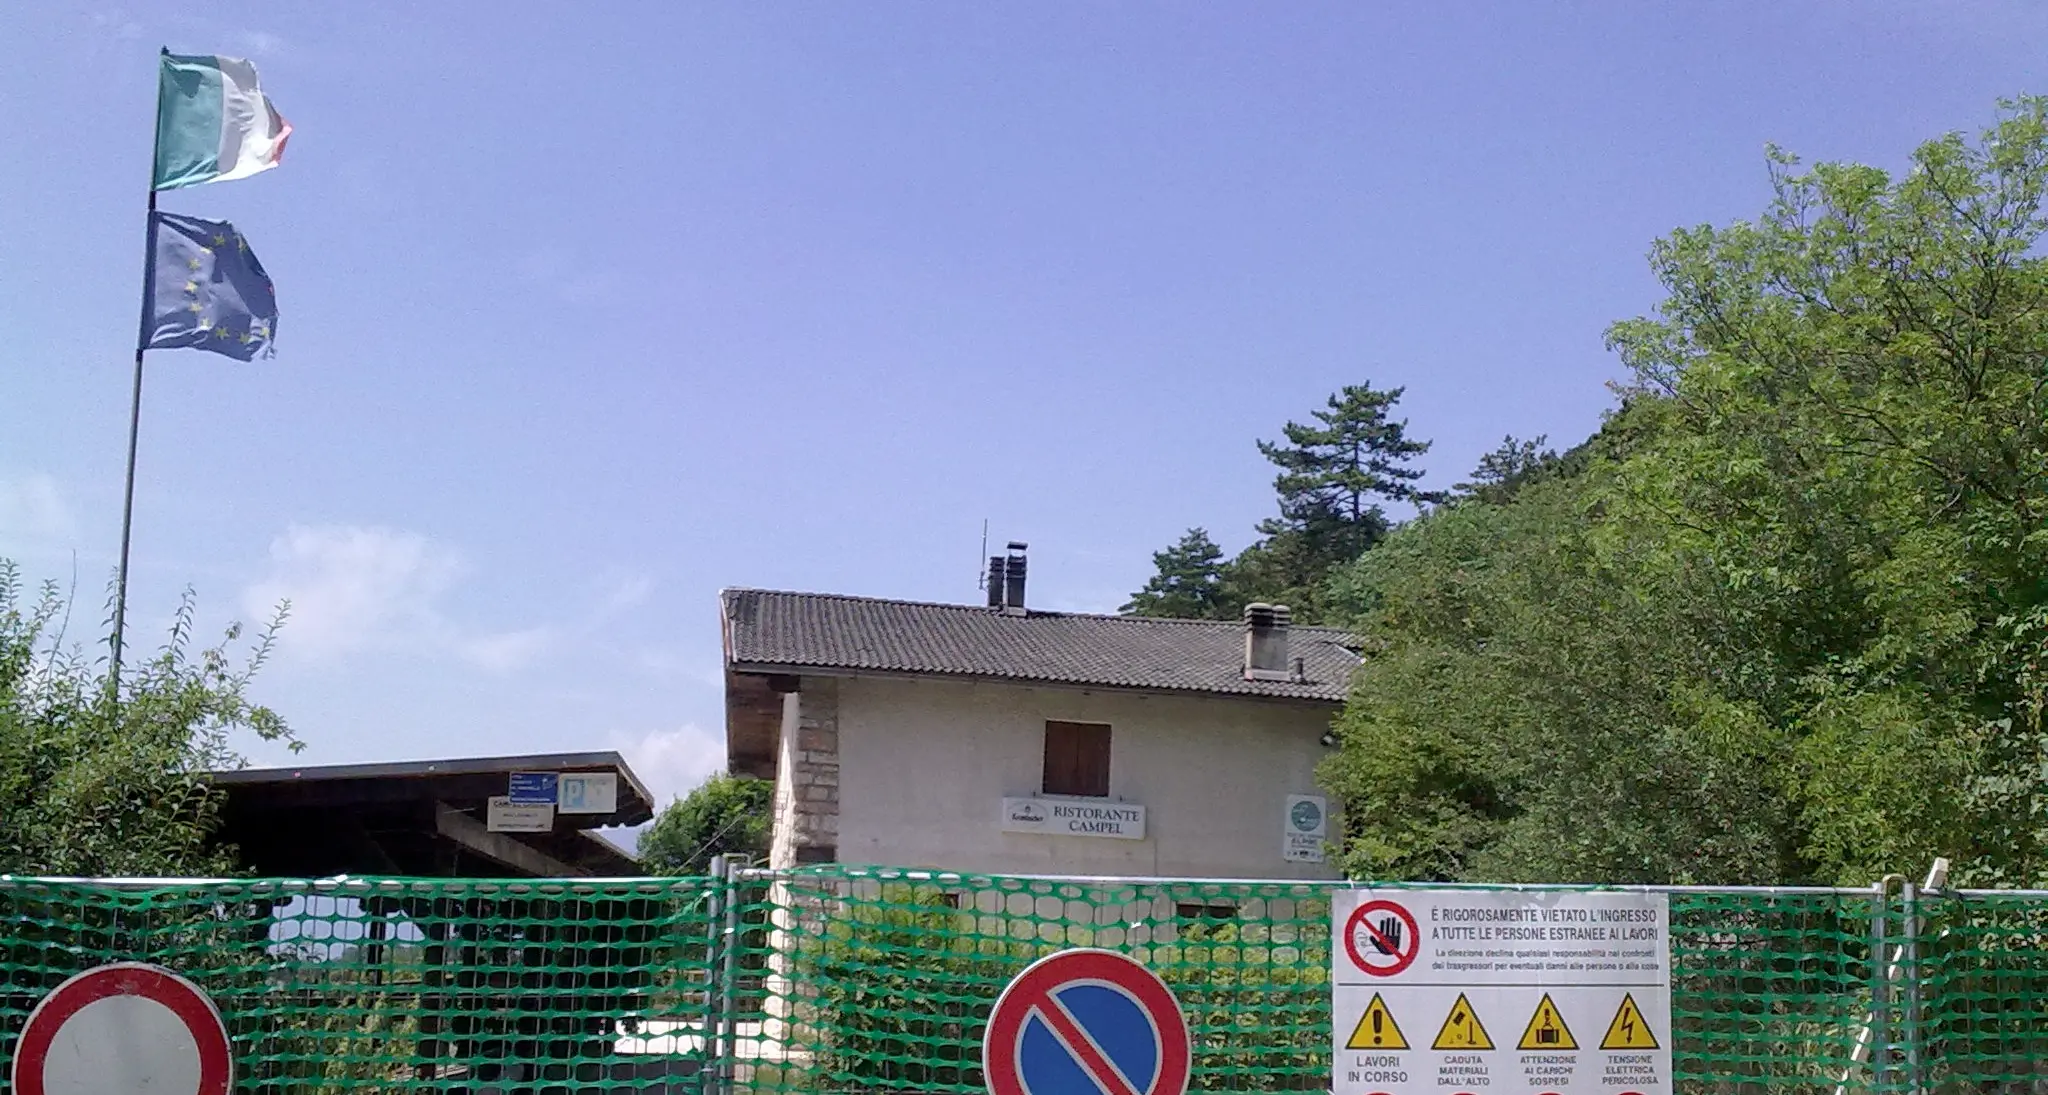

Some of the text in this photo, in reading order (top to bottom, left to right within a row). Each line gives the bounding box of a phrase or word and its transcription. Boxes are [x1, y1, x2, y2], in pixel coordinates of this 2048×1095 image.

[1053, 806, 1140, 822] RISTORANTE
[1069, 820, 1123, 834] CAMPEL
[1443, 908, 1537, 922] RIGOROSAMENTE
[1541, 909, 1587, 923] VIETATO
[1590, 909, 1657, 923] L'INGRESSO
[1432, 926, 1658, 941] A TUTTE LE PERSONE ESTRANEE AI LAVORI
[1436, 949, 1446, 957] La
[1448, 949, 1483, 957] direzione
[1486, 949, 1514, 957] declina
[1516, 949, 1550, 959] qualsiasi
[1622, 949, 1655, 958] confronti
[1432, 962, 1444, 970] dei
[1446, 962, 1493, 972] trasgressori
[1495, 963, 1508, 972] per
[1510, 962, 1544, 970] eventuali
[1546, 962, 1567, 970] danni
[1586, 963, 1617, 972] persone
[1356, 1056, 1400, 1067] LAVORI
[1444, 1056, 1483, 1065] CADUTA
[1520, 1056, 1577, 1064] ATTENZIONE
[1608, 1055, 1652, 1064] TENSIONE
[1439, 1067, 1488, 1075] MATERIALI
[1524, 1066, 1574, 1075] AI CARICHI
[1605, 1066, 1654, 1074] ELETTRICA
[1348, 1071, 1408, 1083] IN CORSO
[1437, 1077, 1490, 1086] DALL'ALTO
[1529, 1077, 1569, 1086] SOSPESI
[1602, 1076, 1659, 1085] PERICOLOSA
